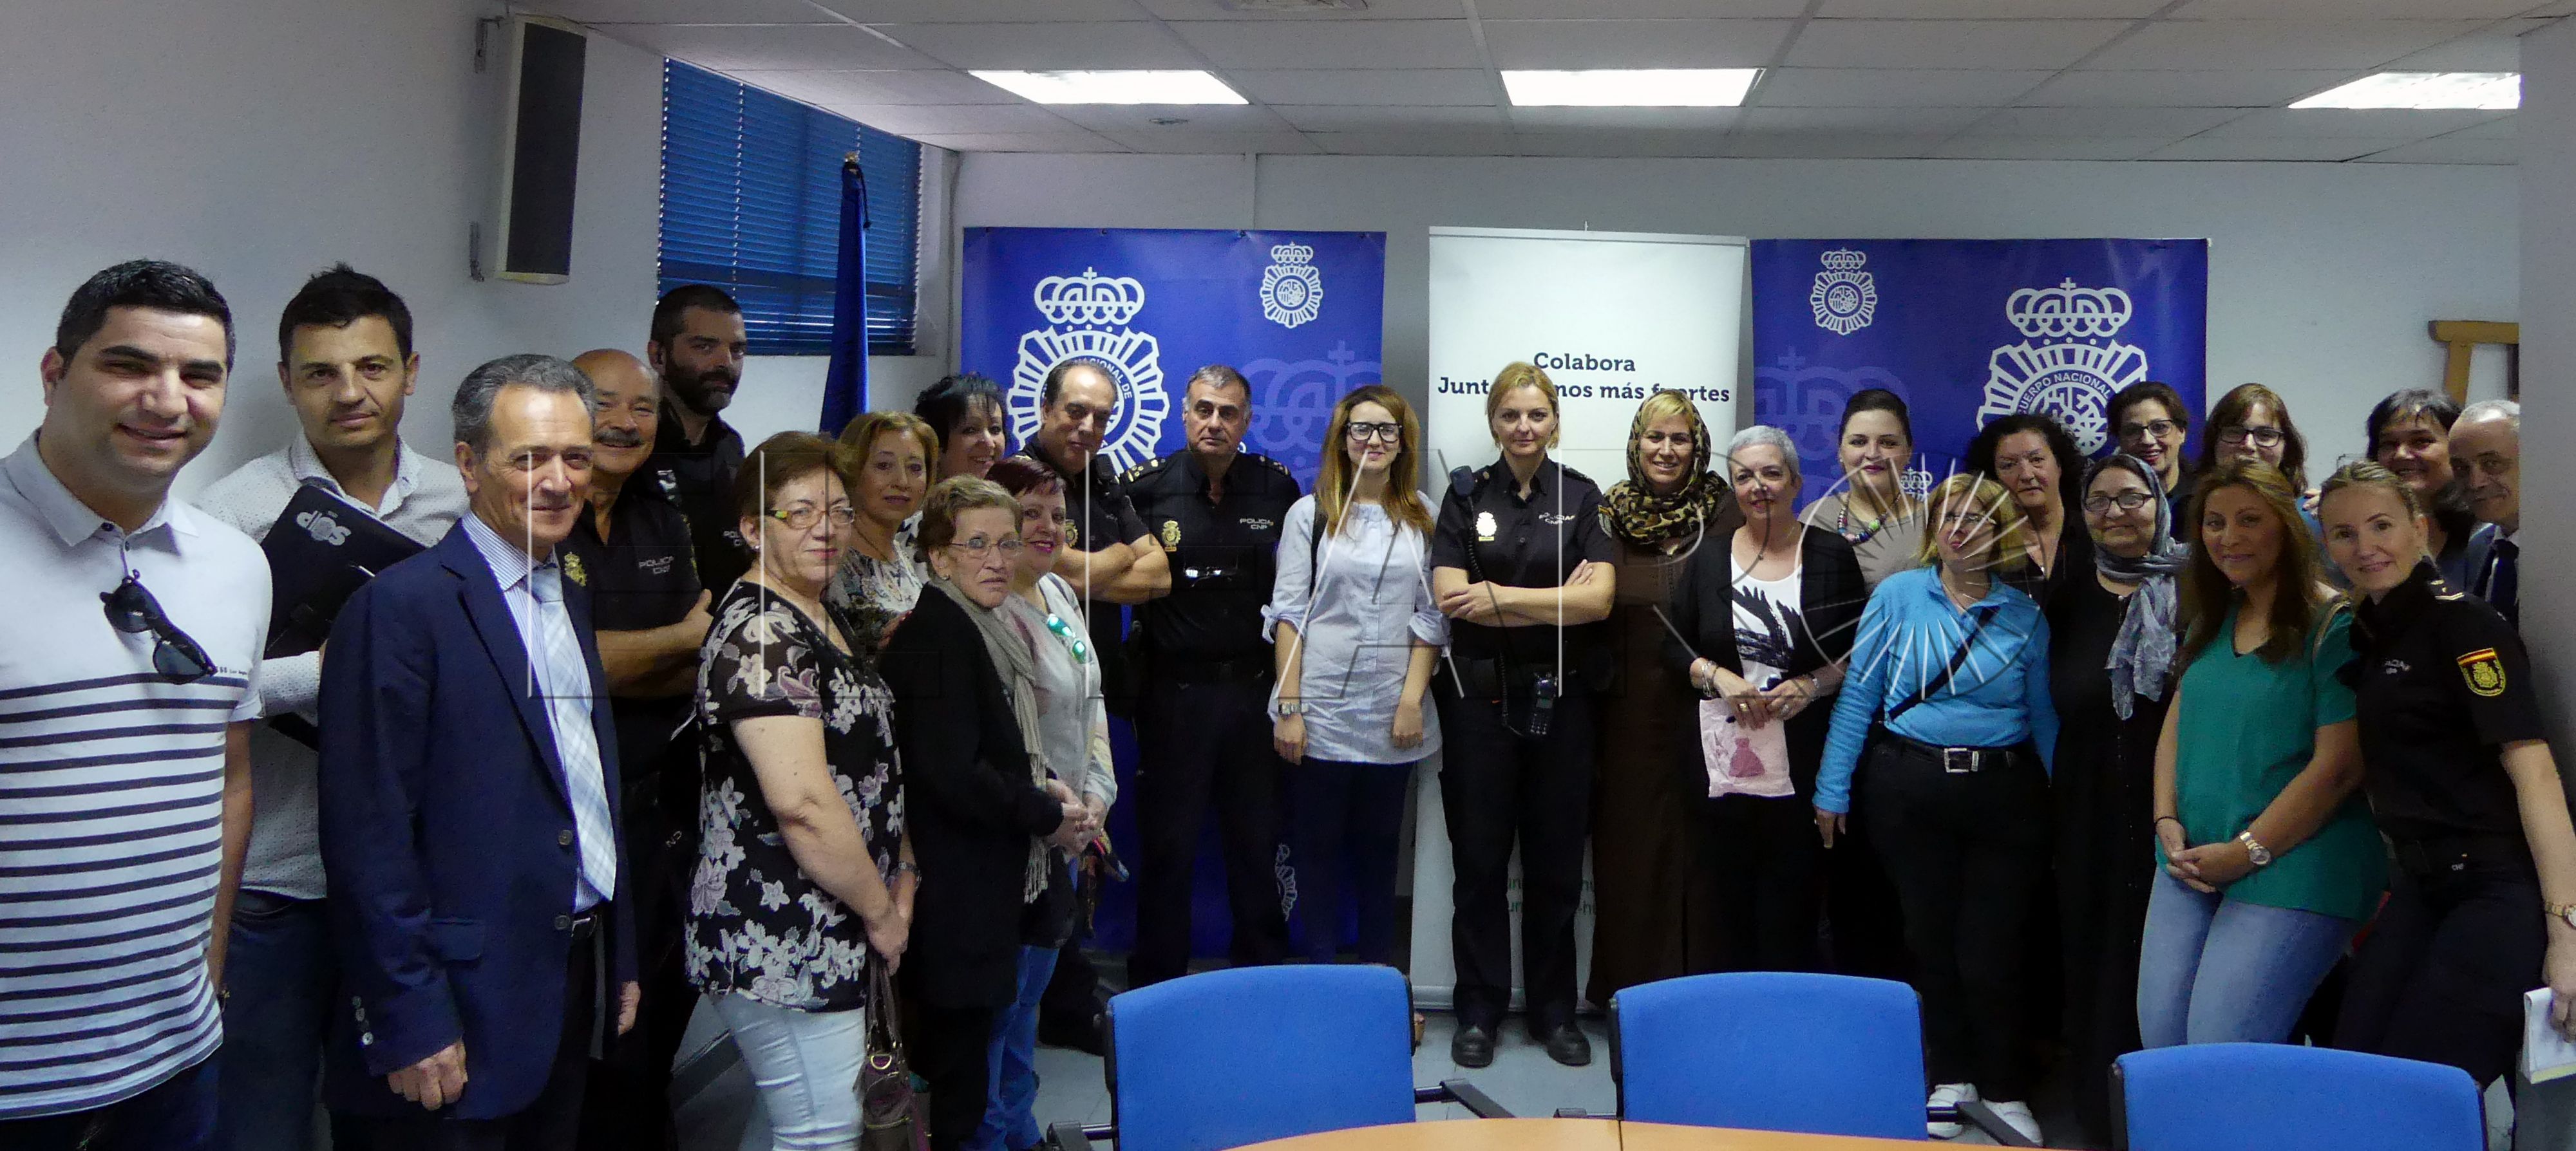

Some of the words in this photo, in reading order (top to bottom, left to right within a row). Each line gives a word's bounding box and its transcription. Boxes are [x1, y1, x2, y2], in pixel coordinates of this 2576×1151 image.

[1533, 352, 1636, 371] Colabora
[1121, 383, 1132, 399] DE
[1437, 377, 1489, 395] Junt
[1554, 384, 1593, 398] mos
[1600, 382, 1644, 399] más
[1651, 382, 1730, 402] frtes
[2054, 373, 2112, 399] NACIONAL
